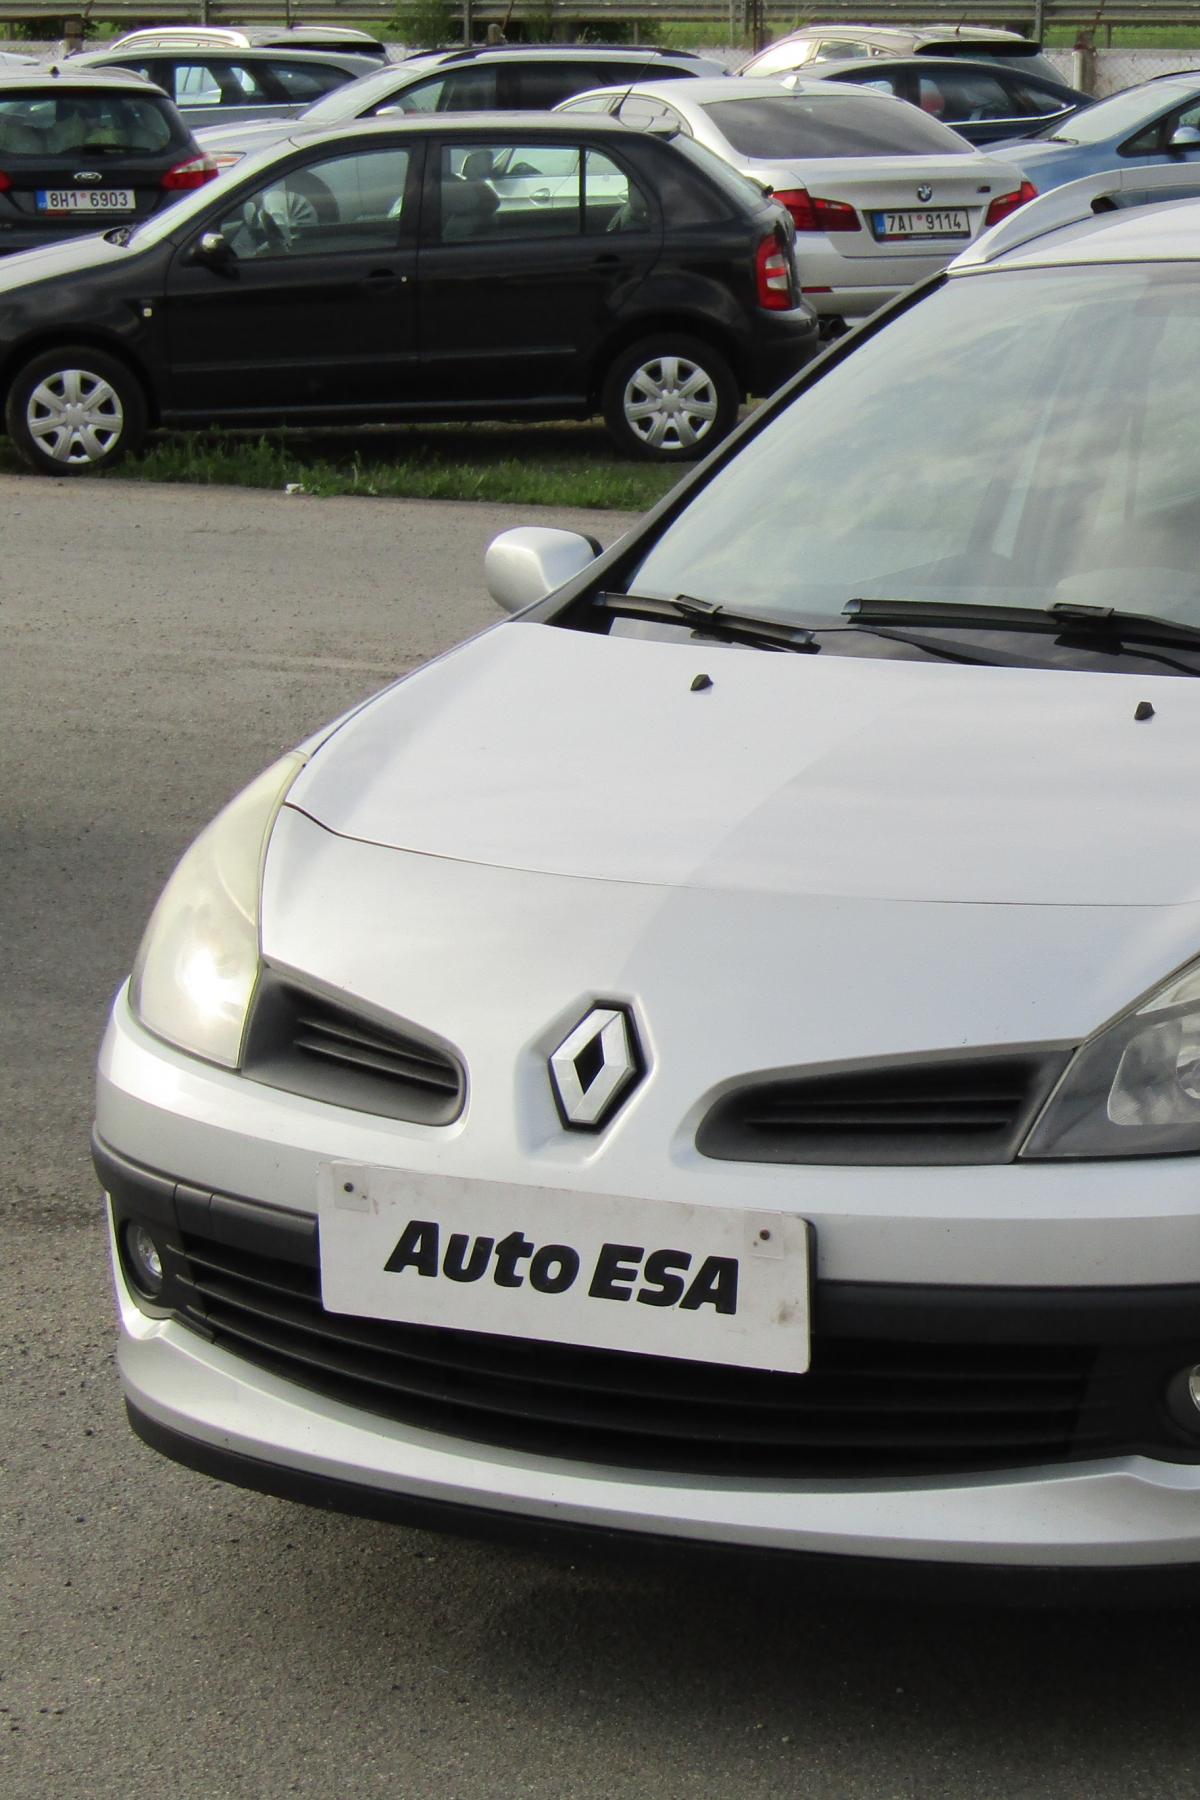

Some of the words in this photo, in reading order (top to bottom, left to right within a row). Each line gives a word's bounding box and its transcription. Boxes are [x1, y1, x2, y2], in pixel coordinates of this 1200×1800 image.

[50, 192, 78, 208] 8H1
[90, 191, 128, 207] 6903
[926, 212, 961, 231] 9114
[384, 1220, 580, 1294] Auto
[588, 1243, 739, 1315] ESA
